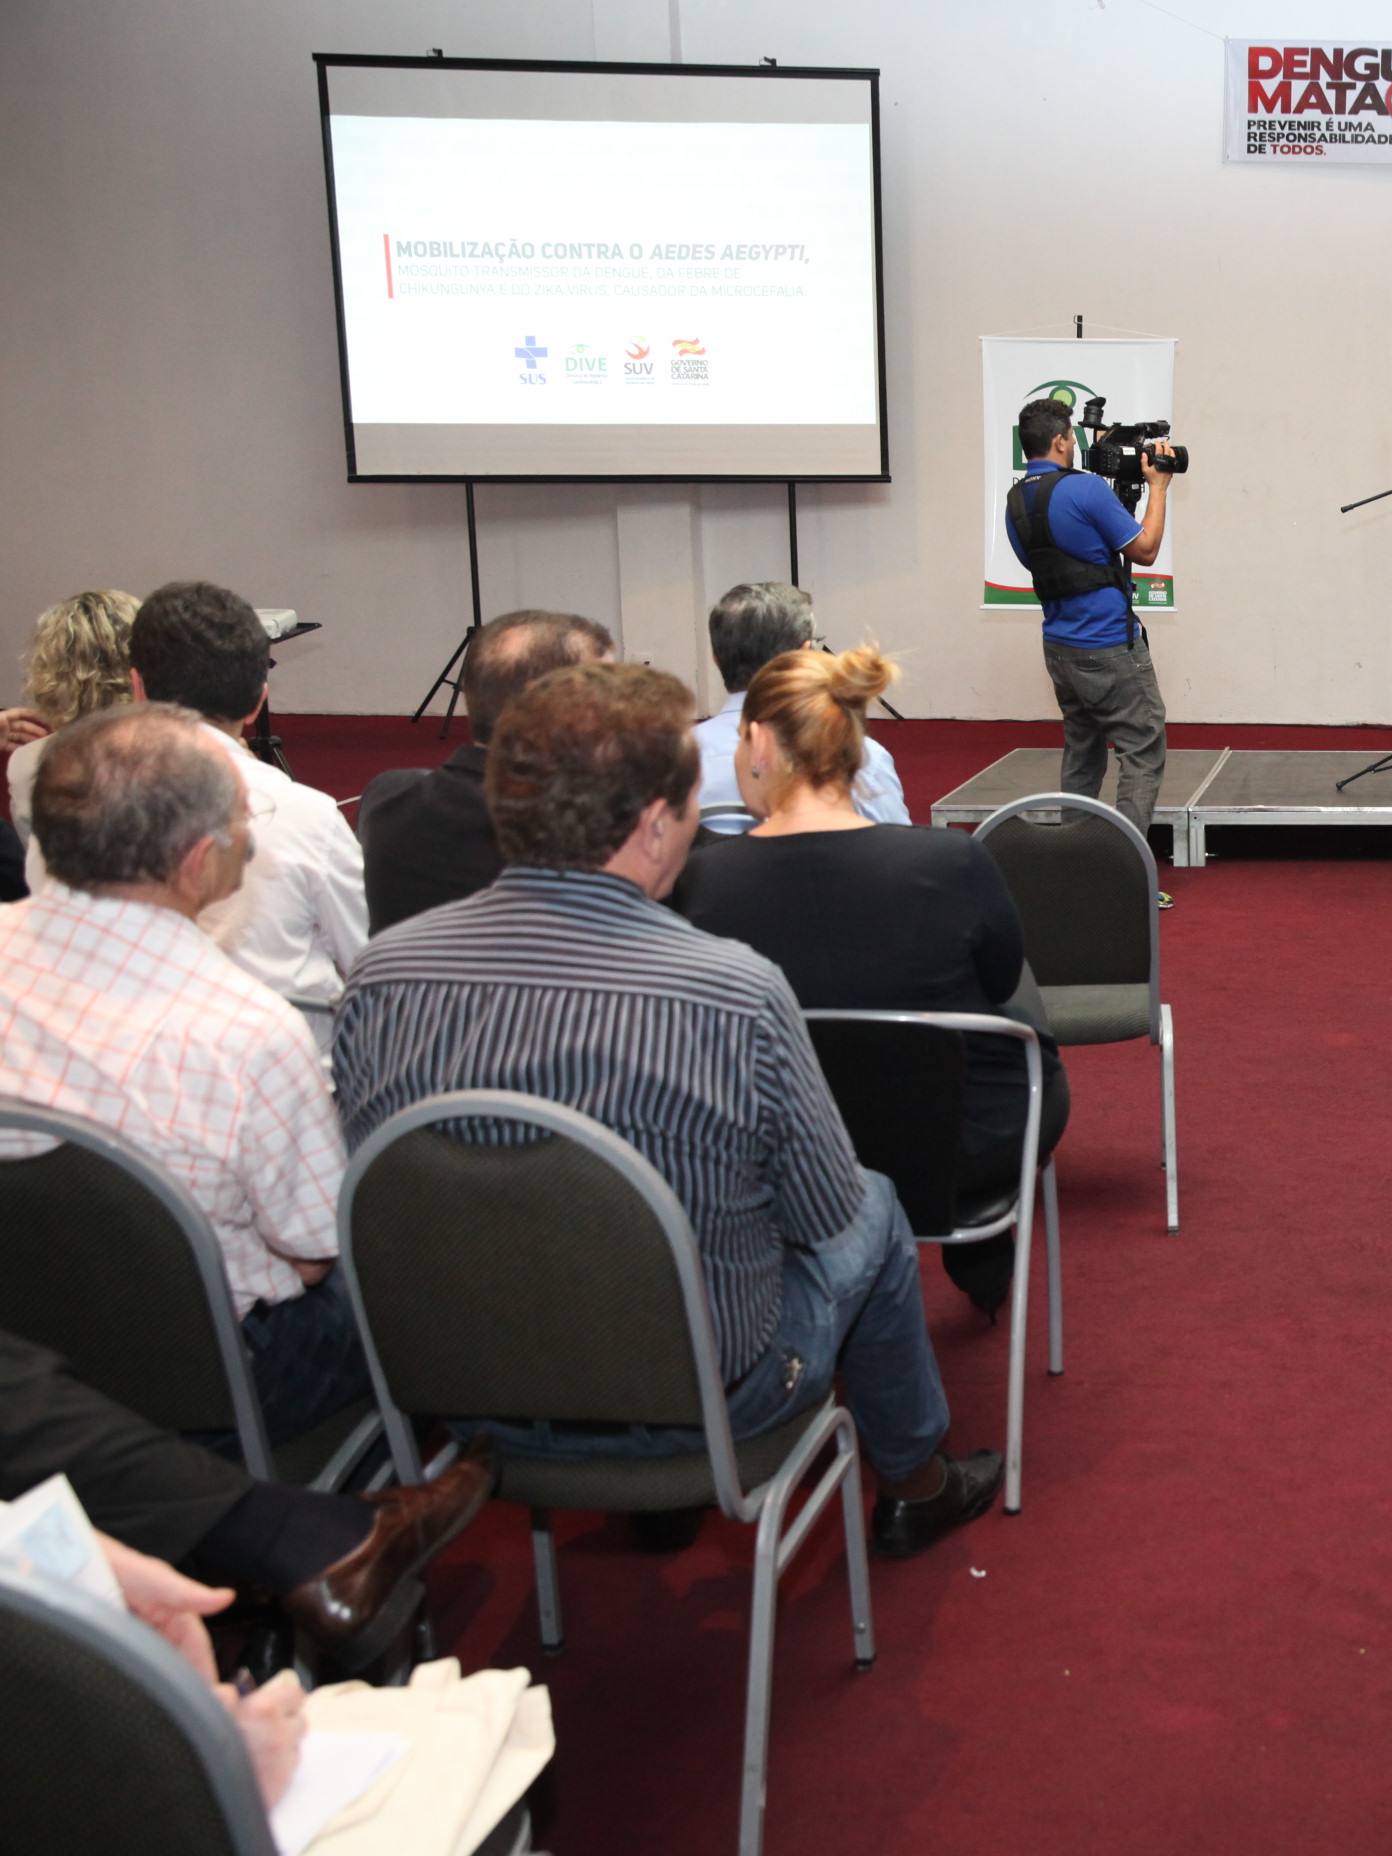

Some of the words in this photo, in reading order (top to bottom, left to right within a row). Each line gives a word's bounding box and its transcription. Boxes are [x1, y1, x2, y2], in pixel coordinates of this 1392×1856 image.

[1248, 80, 1391, 116] MATA
[1247, 119, 1321, 132] PREVENIR
[1325, 118, 1334, 132] É
[1338, 121, 1375, 133] UMA
[1246, 144, 1267, 154] DE
[1270, 144, 1326, 156] TODOS.
[396, 238, 535, 263] MOBILIZAÇÃO
[541, 242, 624, 260] CONTRA
[629, 243, 643, 260] O
[649, 243, 716, 261] AEDES
[720, 244, 810, 264] AEGYPTI,
[398, 263, 470, 277] MOSQUITO
[474, 265, 568, 278] TRANSMISSOR
[573, 266, 591, 278] DA
[656, 267, 675, 279] DA
[678, 267, 720, 279] FEBRE
[724, 267, 742, 279] DE
[398, 282, 495, 295] CHIKUNGUNYA
[499, 283, 507, 295] E
[511, 283, 530, 295] DO
[534, 283, 562, 296] ZIKA
[614, 284, 686, 297] CAUSADOR
[690, 285, 708, 297] DA
[565, 357, 608, 372] DIVE
[624, 362, 653, 375] SUV
[671, 359, 709, 367] GOVERNO
[671, 366, 682, 374] DE
[683, 366, 709, 374] SANTA
[519, 373, 547, 385] SUS
